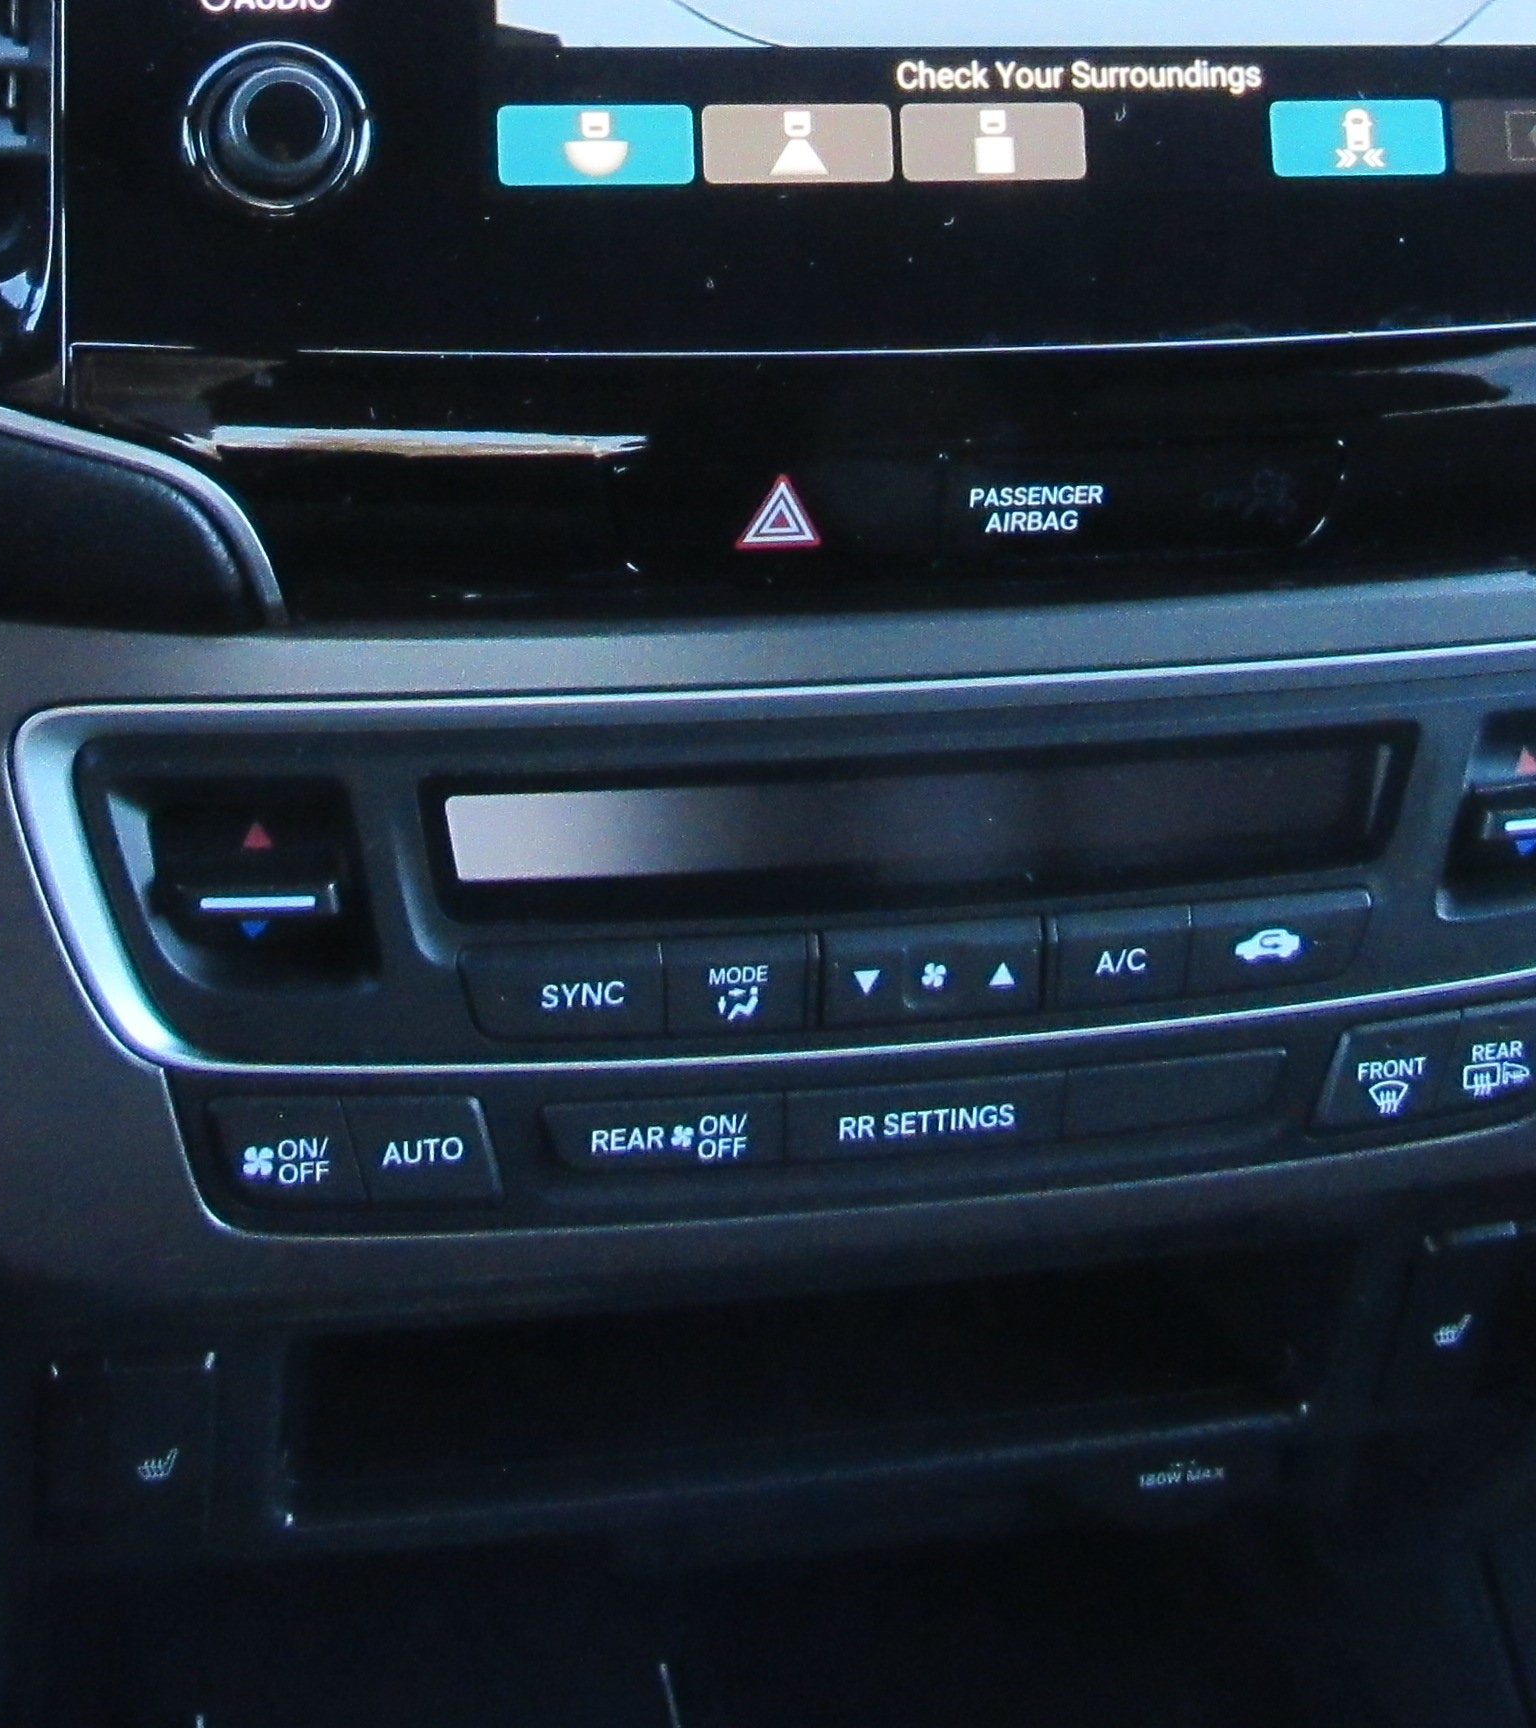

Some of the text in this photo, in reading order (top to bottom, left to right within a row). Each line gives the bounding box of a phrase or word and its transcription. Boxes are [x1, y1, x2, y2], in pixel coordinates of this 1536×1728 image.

[897, 59, 1262, 94] Check Your Surroundings
[970, 485, 1103, 508] PASSENGER
[985, 510, 1078, 532] AIRBAG
[1096, 948, 1146, 975] A/C
[709, 965, 768, 986] MODE
[542, 981, 624, 1009] SYNC
[1472, 1041, 1525, 1064] REAR
[1358, 1057, 1426, 1082] FRONT
[699, 1114, 747, 1137] ON/
[839, 1104, 1014, 1141] RR SETTINGS
[278, 1138, 329, 1162] ON/
[382, 1137, 463, 1166] AUTO
[592, 1126, 664, 1153] REAR
[698, 1135, 746, 1160] OFF
[279, 1161, 329, 1184] OFF
